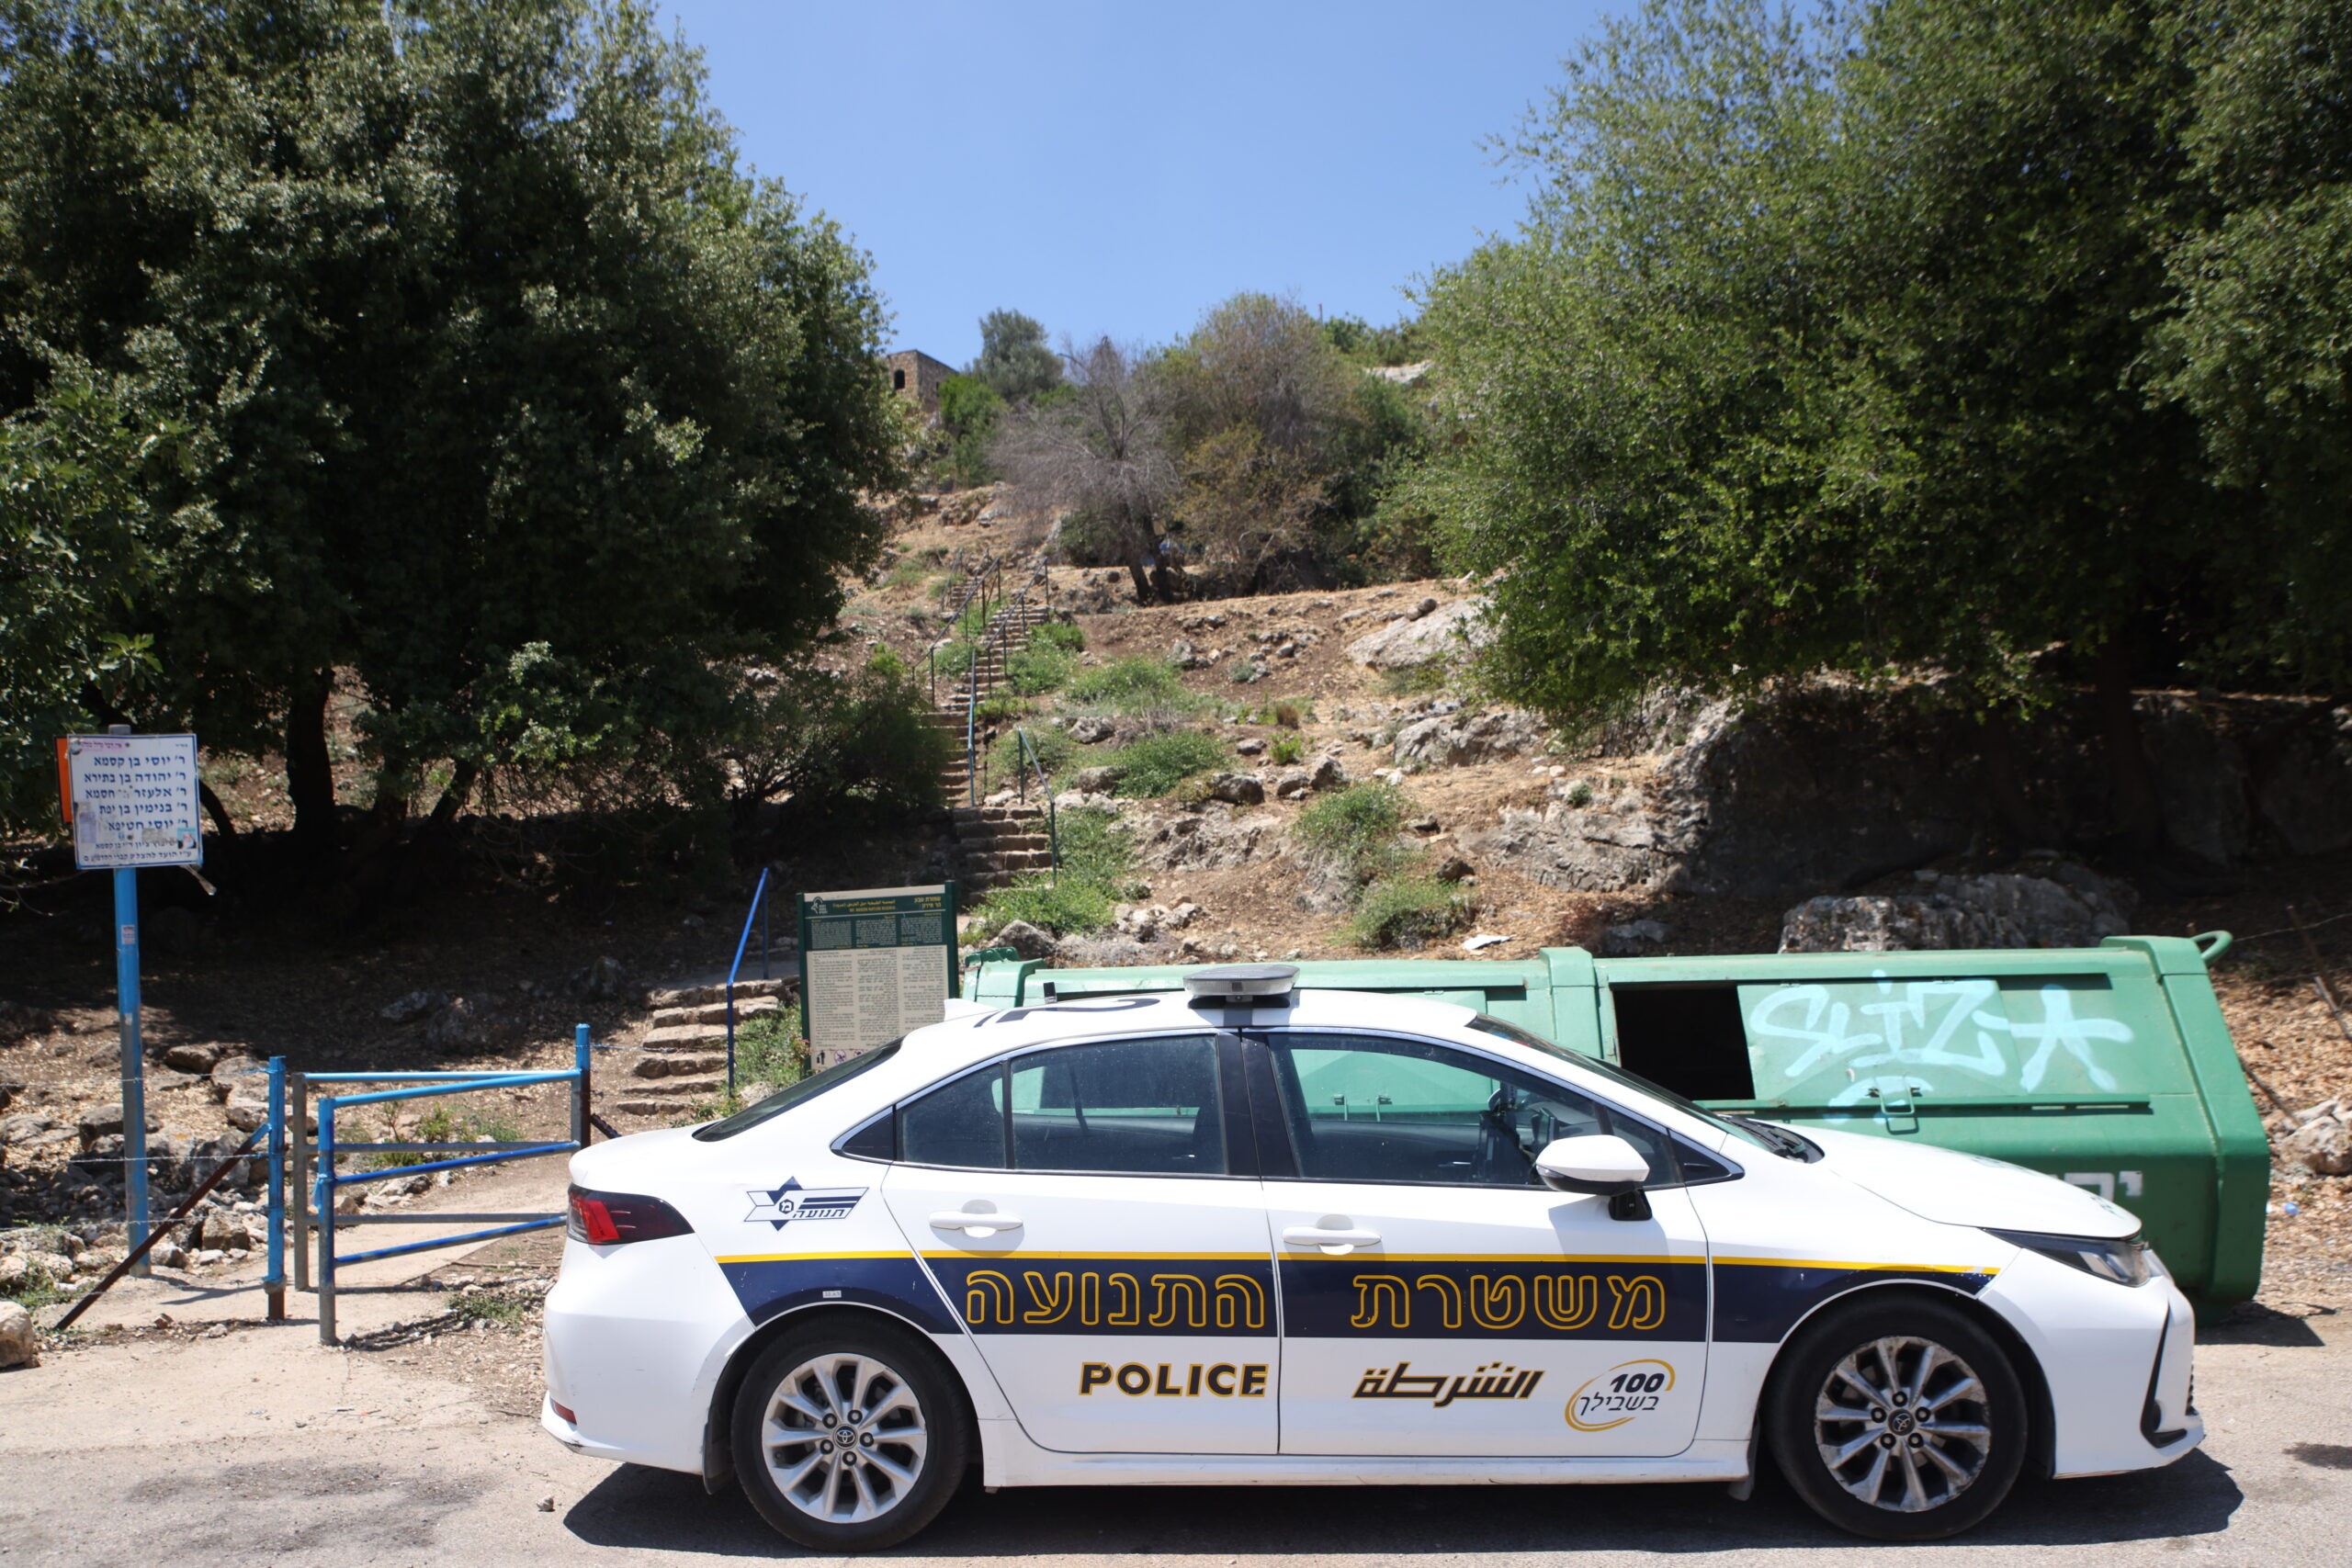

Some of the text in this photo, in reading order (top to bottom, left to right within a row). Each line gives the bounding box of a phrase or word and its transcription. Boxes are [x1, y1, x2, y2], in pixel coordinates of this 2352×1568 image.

[94, 756, 125, 768] קסמא
[129, 757, 141, 768] בן
[146, 757, 171, 766] יוסי
[85, 773, 116, 783] בתירא
[119, 773, 130, 784] בן
[135, 773, 171, 782] יהודה
[85, 789, 115, 799] חסמא
[134, 787, 172, 798] אלעזר
[119, 805, 130, 816] בן
[134, 803, 172, 816] בנימין
[149, 820, 174, 830] יוסי
[793, 1209, 844, 1219] תנועה
[966, 1269, 1666, 1330] משטרת התנועה
[1079, 1361, 1270, 1397] POLICE
[1610, 1372, 1665, 1393] 100
[1351, 1361, 1546, 1409] الشرطة
[1579, 1395, 1660, 1416] בשבילך
